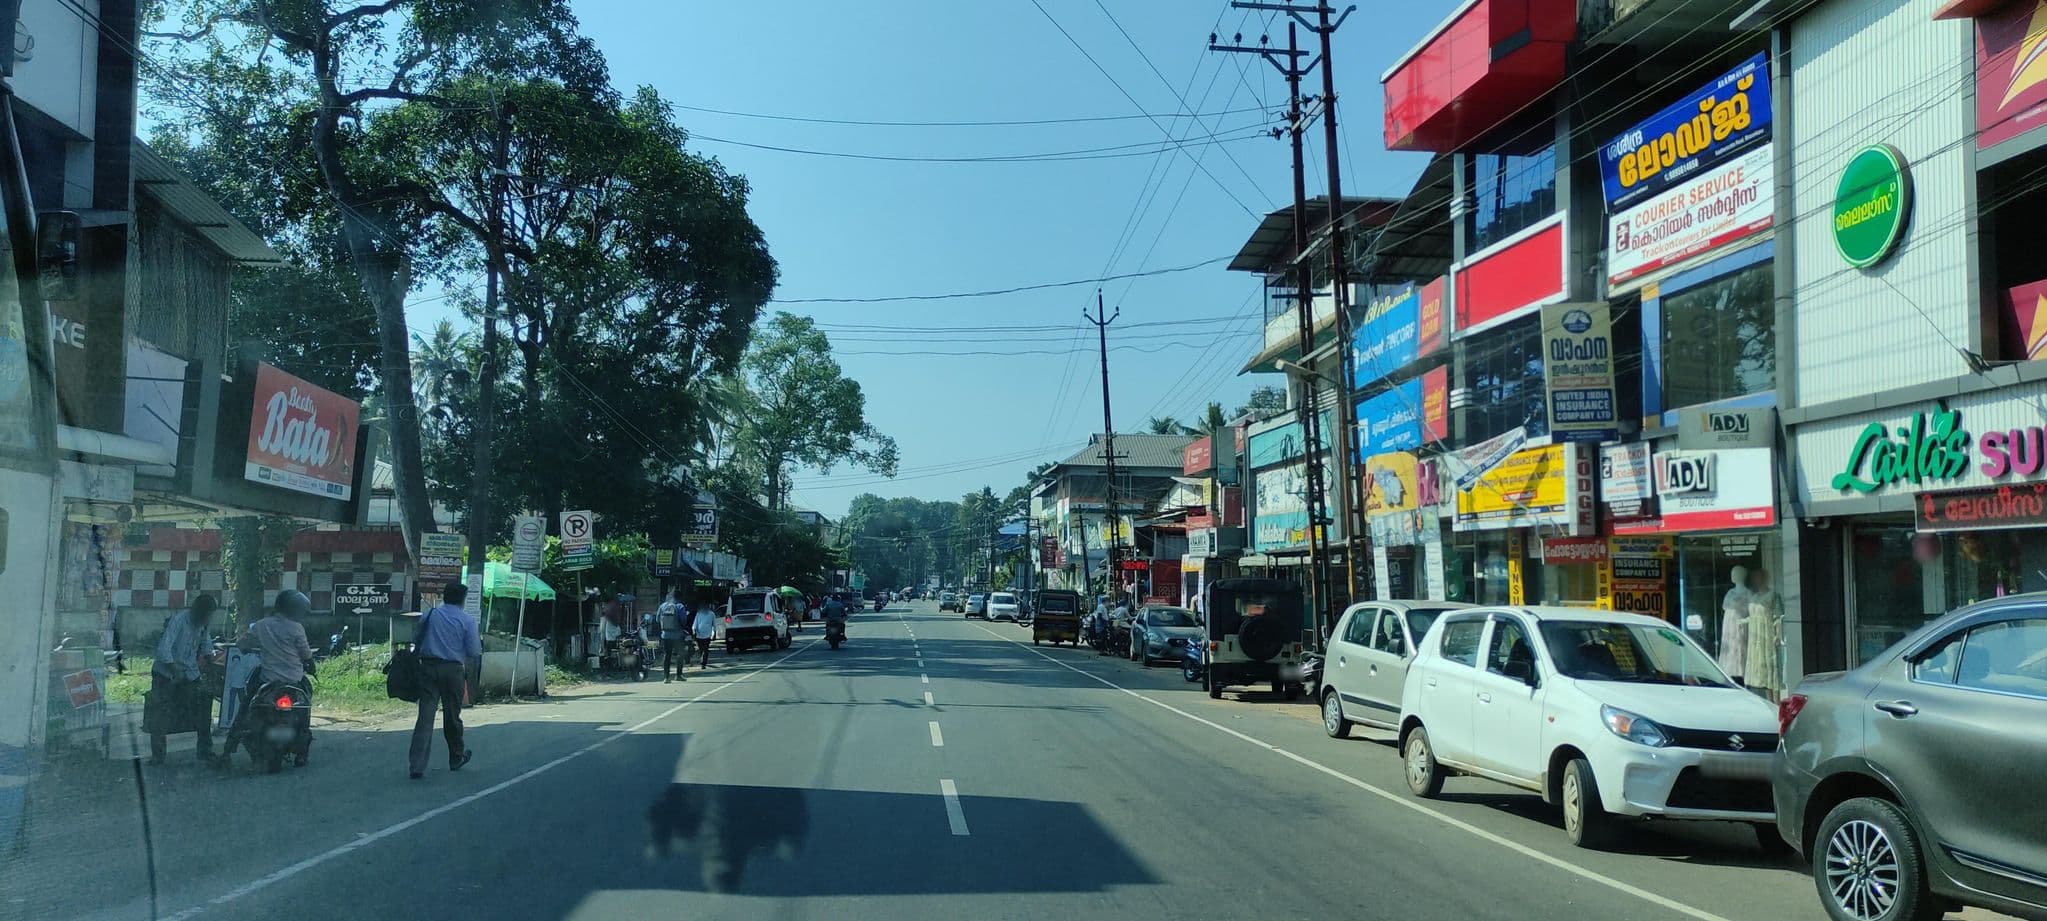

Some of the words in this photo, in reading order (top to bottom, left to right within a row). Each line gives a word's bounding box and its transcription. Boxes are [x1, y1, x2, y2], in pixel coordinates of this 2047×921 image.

[1618, 73, 1754, 187] ലോഡ്ജ്
[1635, 194, 1685, 228] COURIER
[1689, 166, 1745, 206] SERVICE
[1631, 210, 1693, 250] കൊറിയർ
[1422, 298, 1440, 320] GOLD
[1550, 337, 1608, 360] വാഹന
[1555, 391, 1585, 401] UNITED
[1586, 390, 1609, 400] INDIA
[1556, 399, 1610, 412] INSURANCE
[1556, 410, 1596, 421] COMPANY
[1596, 410, 1612, 420] LTD
[1702, 413, 1750, 433] LADY
[258, 391, 331, 468] Bata
[1980, 424, 2047, 478] SU
[1654, 452, 1711, 494] LADY
[1577, 446, 1592, 526] LODGE
[1944, 484, 2045, 522] ലേഡീസ്
[1614, 558, 1661, 568] INSURANCE
[1615, 568, 1647, 578] COMPANY
[1647, 568, 1661, 577] LTD
[336, 593, 389, 607] സലൂൺ
[346, 586, 381, 595] G.K.
[1613, 591, 1663, 612] വാഹന
